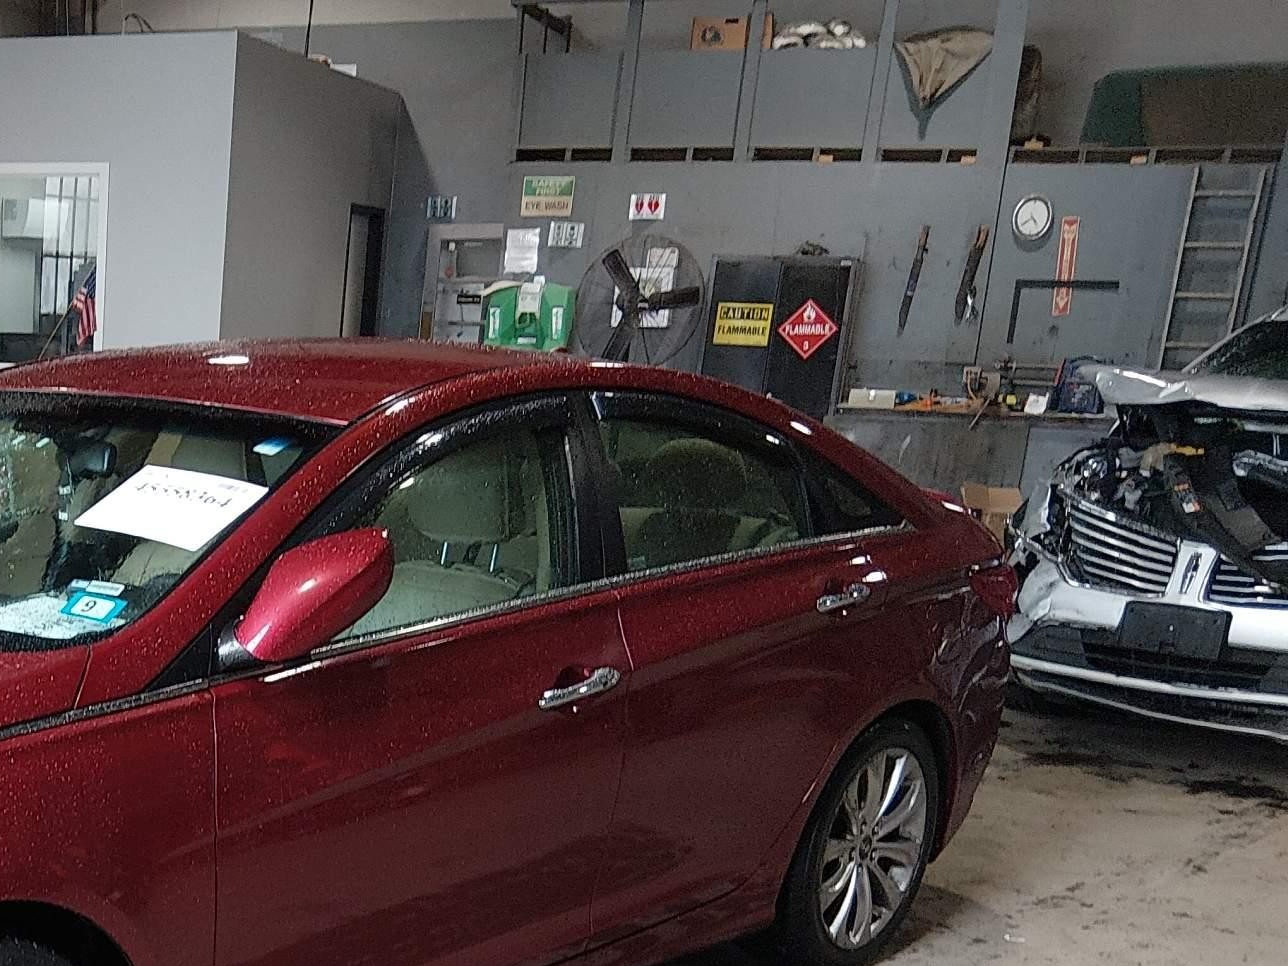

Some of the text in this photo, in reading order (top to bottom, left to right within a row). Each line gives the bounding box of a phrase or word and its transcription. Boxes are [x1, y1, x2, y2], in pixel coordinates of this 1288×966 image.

[525, 200, 569, 210] EYE WASH
[720, 306, 770, 320] CAUTION
[717, 325, 767, 336] FLAMMABLE
[785, 323, 830, 336] FLAMMABLE
